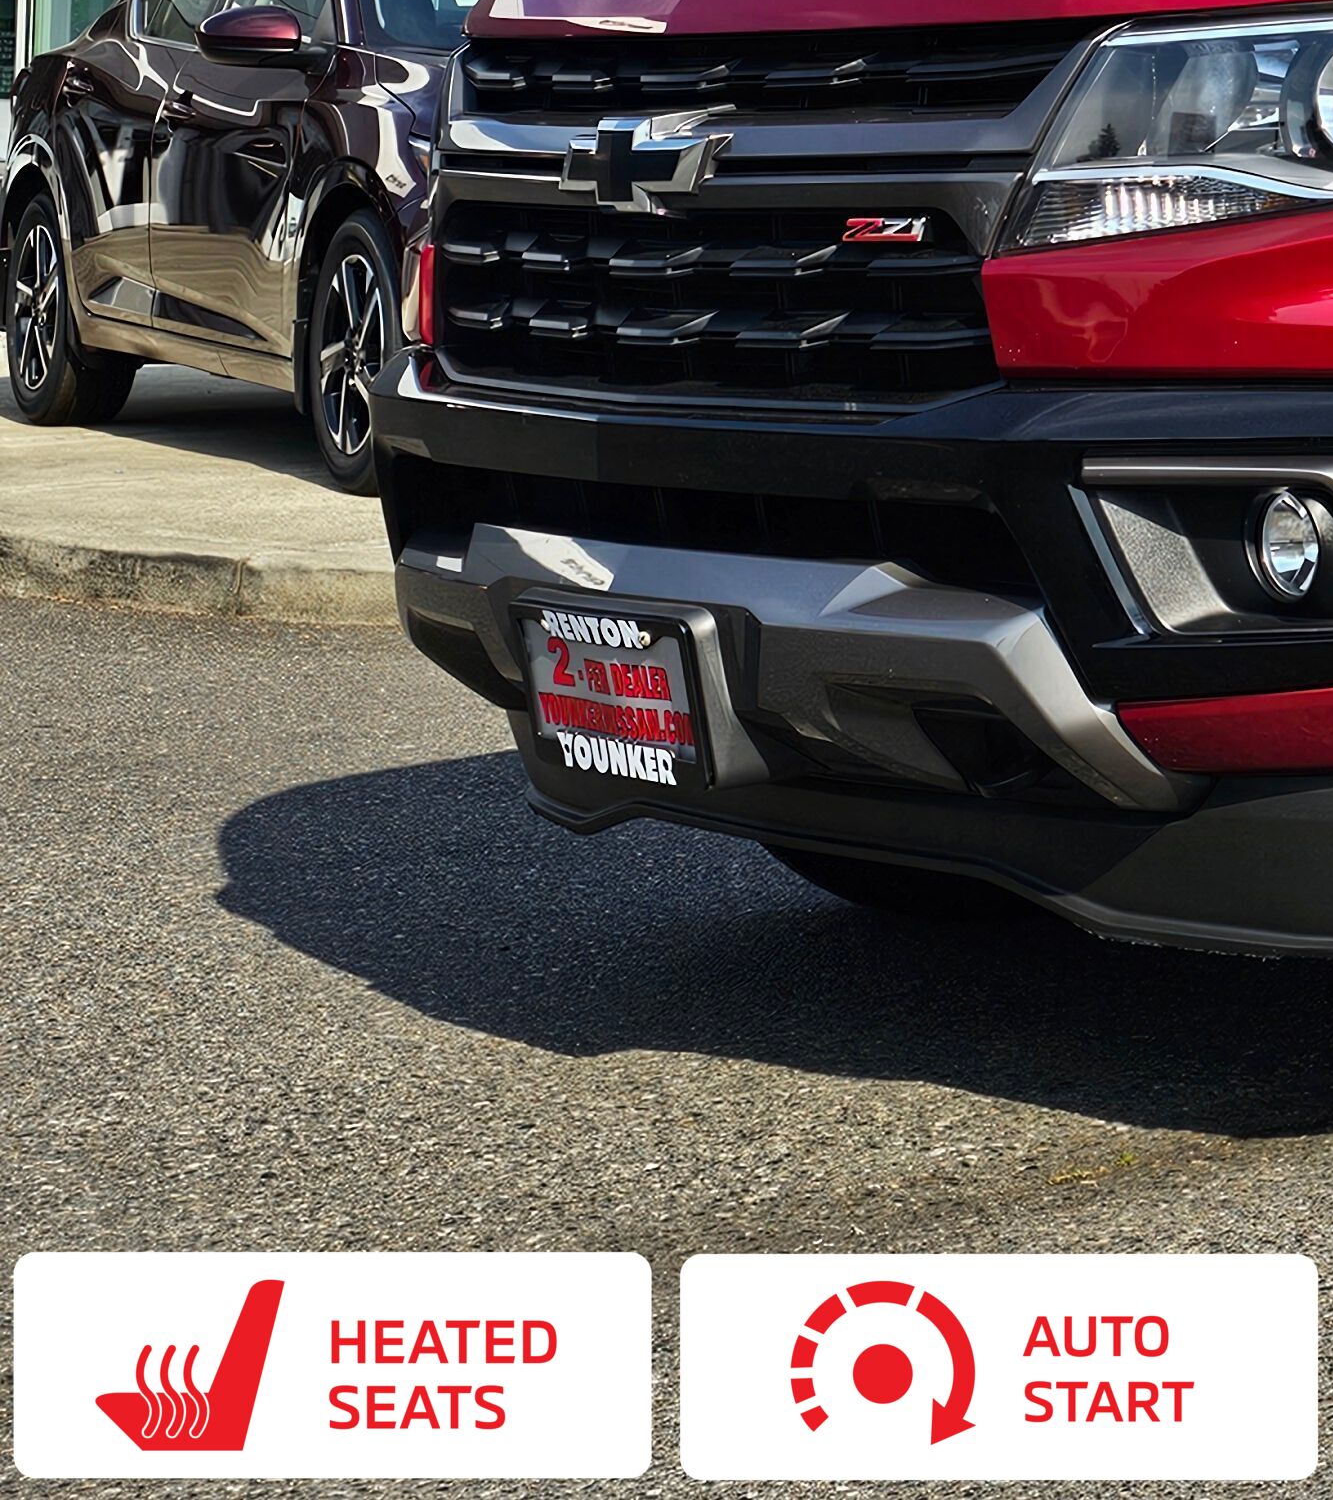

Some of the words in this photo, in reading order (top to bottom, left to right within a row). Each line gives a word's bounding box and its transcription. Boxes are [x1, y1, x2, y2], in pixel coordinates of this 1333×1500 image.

[842, 216, 928, 242] Z71
[542, 609, 645, 650] RENTON
[609, 662, 672, 701] DEALER
[556, 731, 677, 786] YOUNKER
